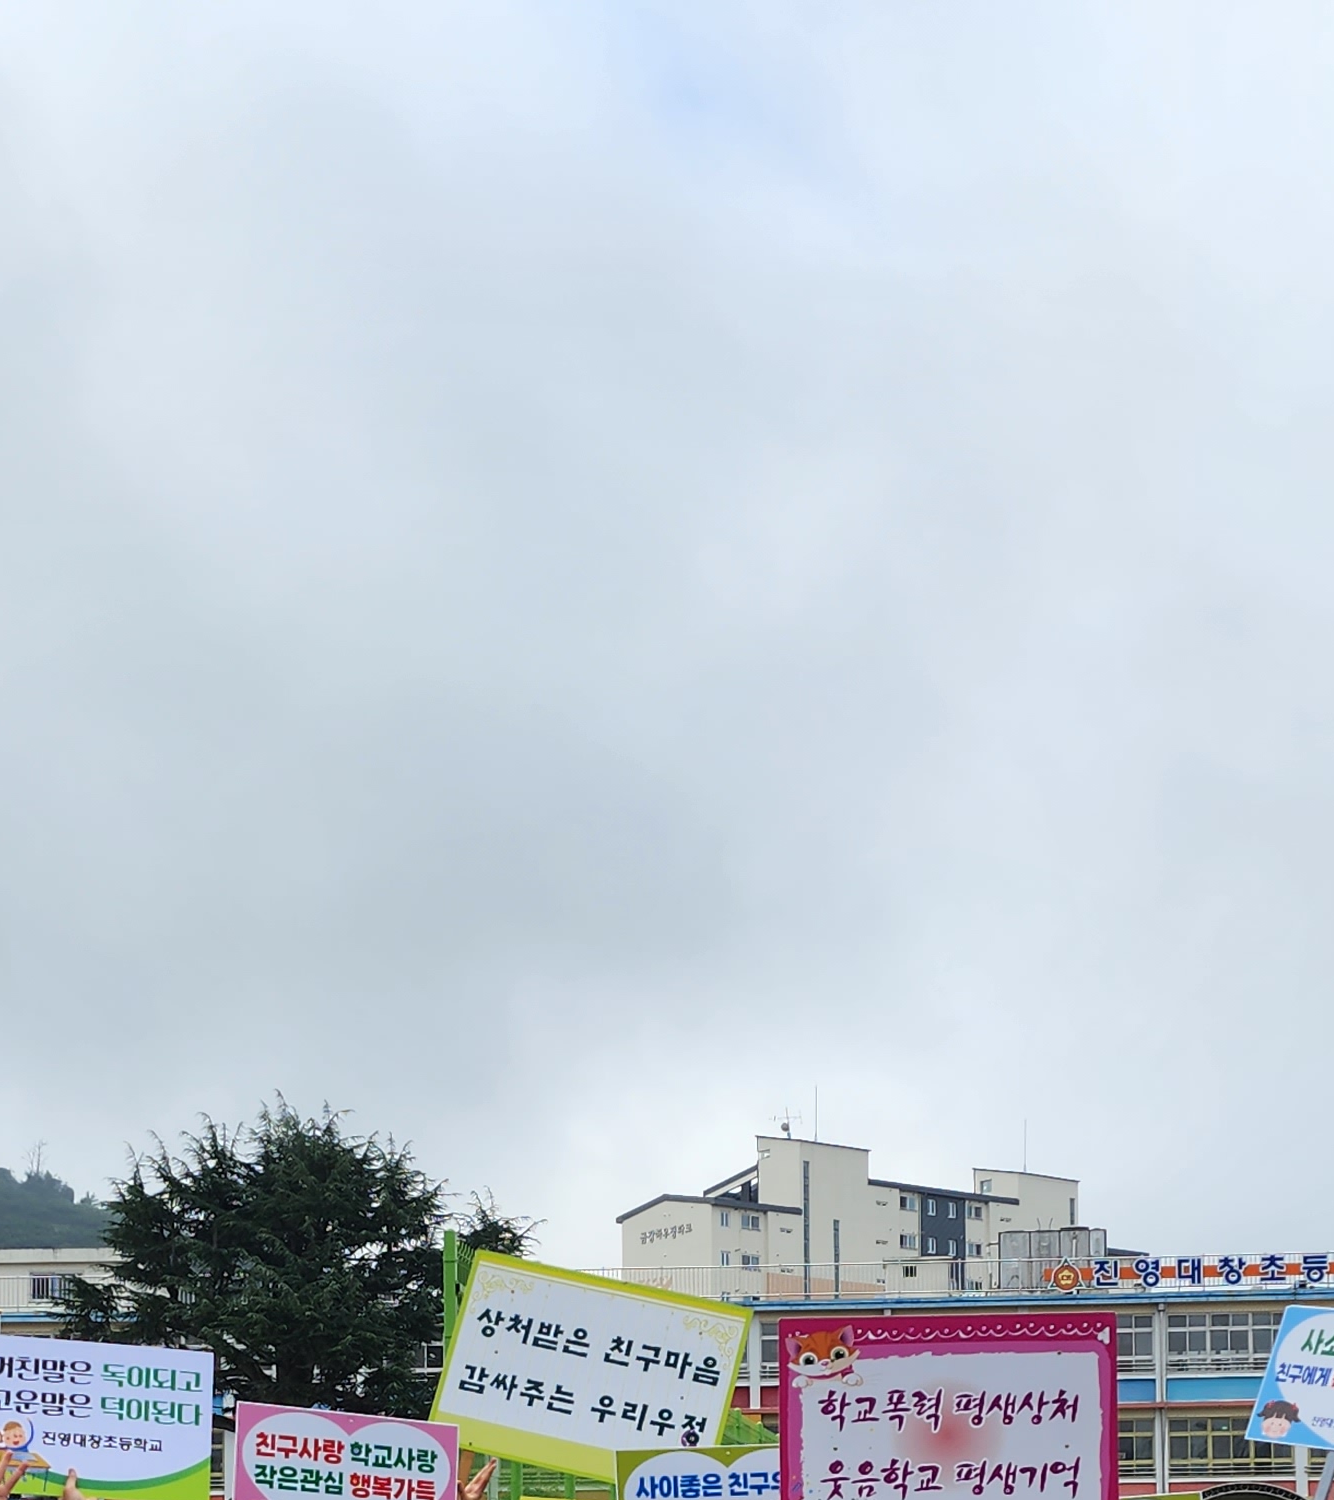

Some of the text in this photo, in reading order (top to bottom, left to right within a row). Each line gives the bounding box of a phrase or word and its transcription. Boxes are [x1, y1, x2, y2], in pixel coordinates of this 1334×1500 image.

[477, 1307, 721, 1387] 상처받은 친구마음
[100, 1363, 203, 1393] 독이되고
[1275, 1362, 1333, 1387] 친구에게
[100, 1395, 203, 1427] 덕이된다
[458, 1363, 708, 1447] 감싸주는 우리우정
[818, 1388, 1080, 1433] 학교폭력 평생상처
[41, 1430, 164, 1453] 진영대창초등학교
[255, 1431, 438, 1474] 친구사랑 학교사랑
[254, 1463, 344, 1496] 작은관심
[635, 1474, 724, 1500] 사이좋은
[820, 1455, 1081, 1500] 웃음학교 평생기억
